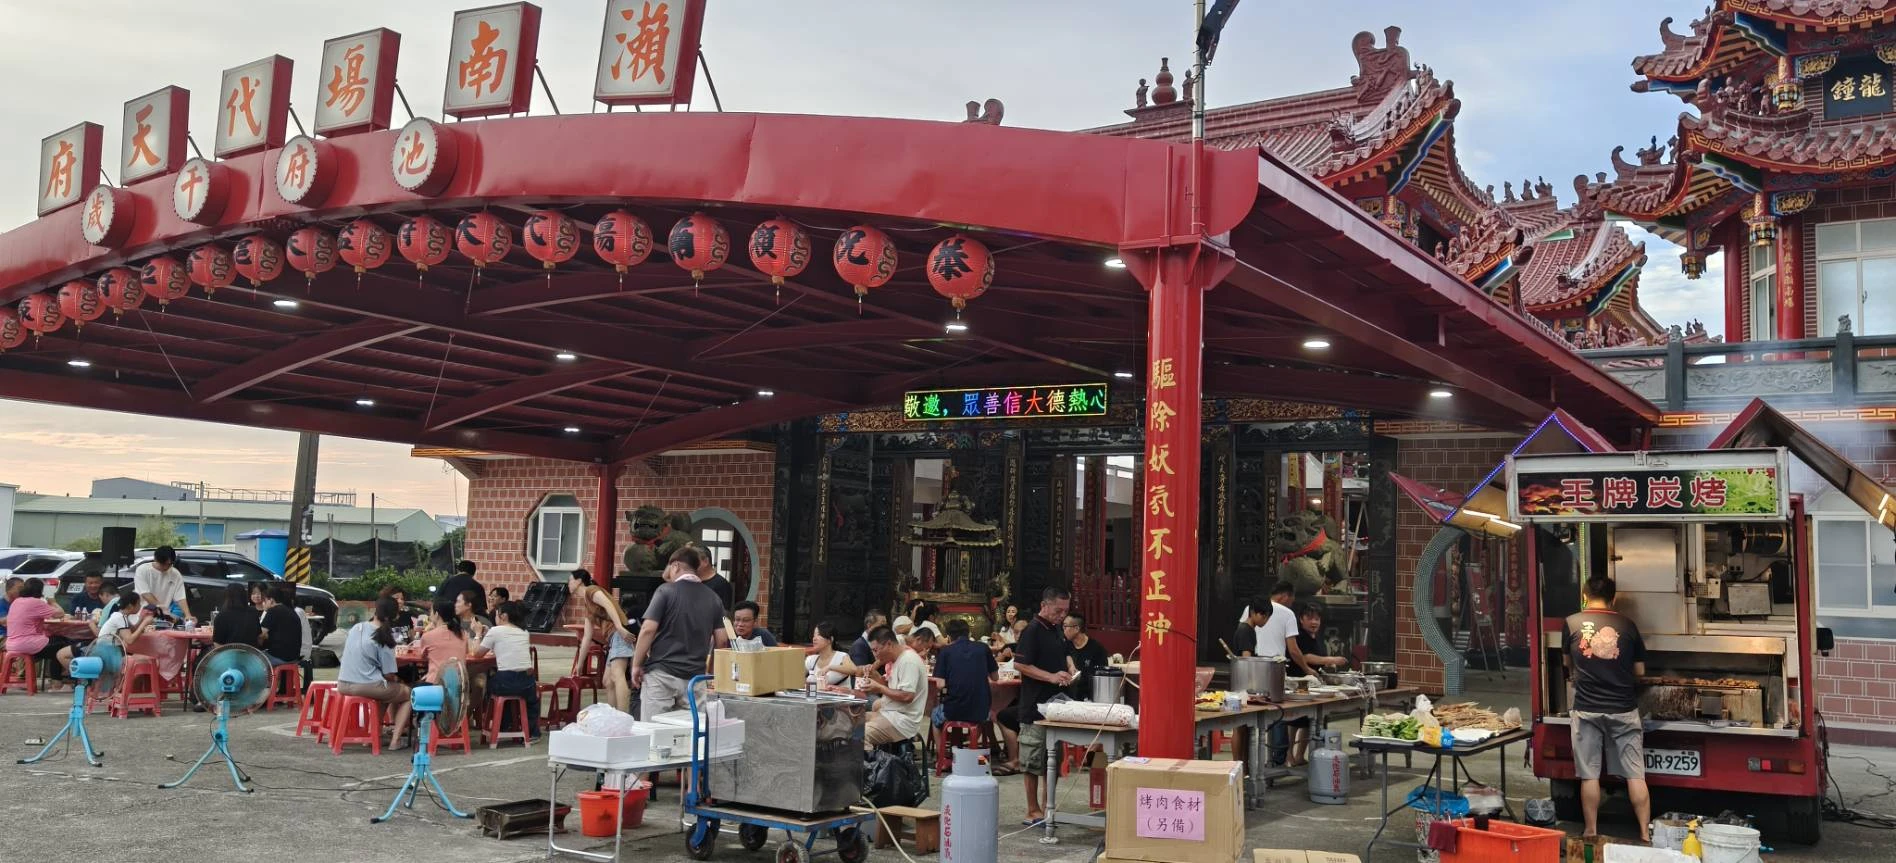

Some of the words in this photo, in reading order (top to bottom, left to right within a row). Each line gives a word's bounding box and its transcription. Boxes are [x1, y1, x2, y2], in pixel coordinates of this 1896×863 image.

[325, 43, 369, 117] 場
[459, 20, 507, 98] 南
[226, 77, 263, 137] 代
[127, 104, 160, 168] 天
[399, 130, 428, 176] 池
[47, 140, 77, 198] 府
[284, 143, 310, 189] 府
[1561, 475, 1728, 509] 王牌炭烤
[1643, 753, 1699, 771] DR-9259
[1140, 794, 1201, 812] 烤肉食材
